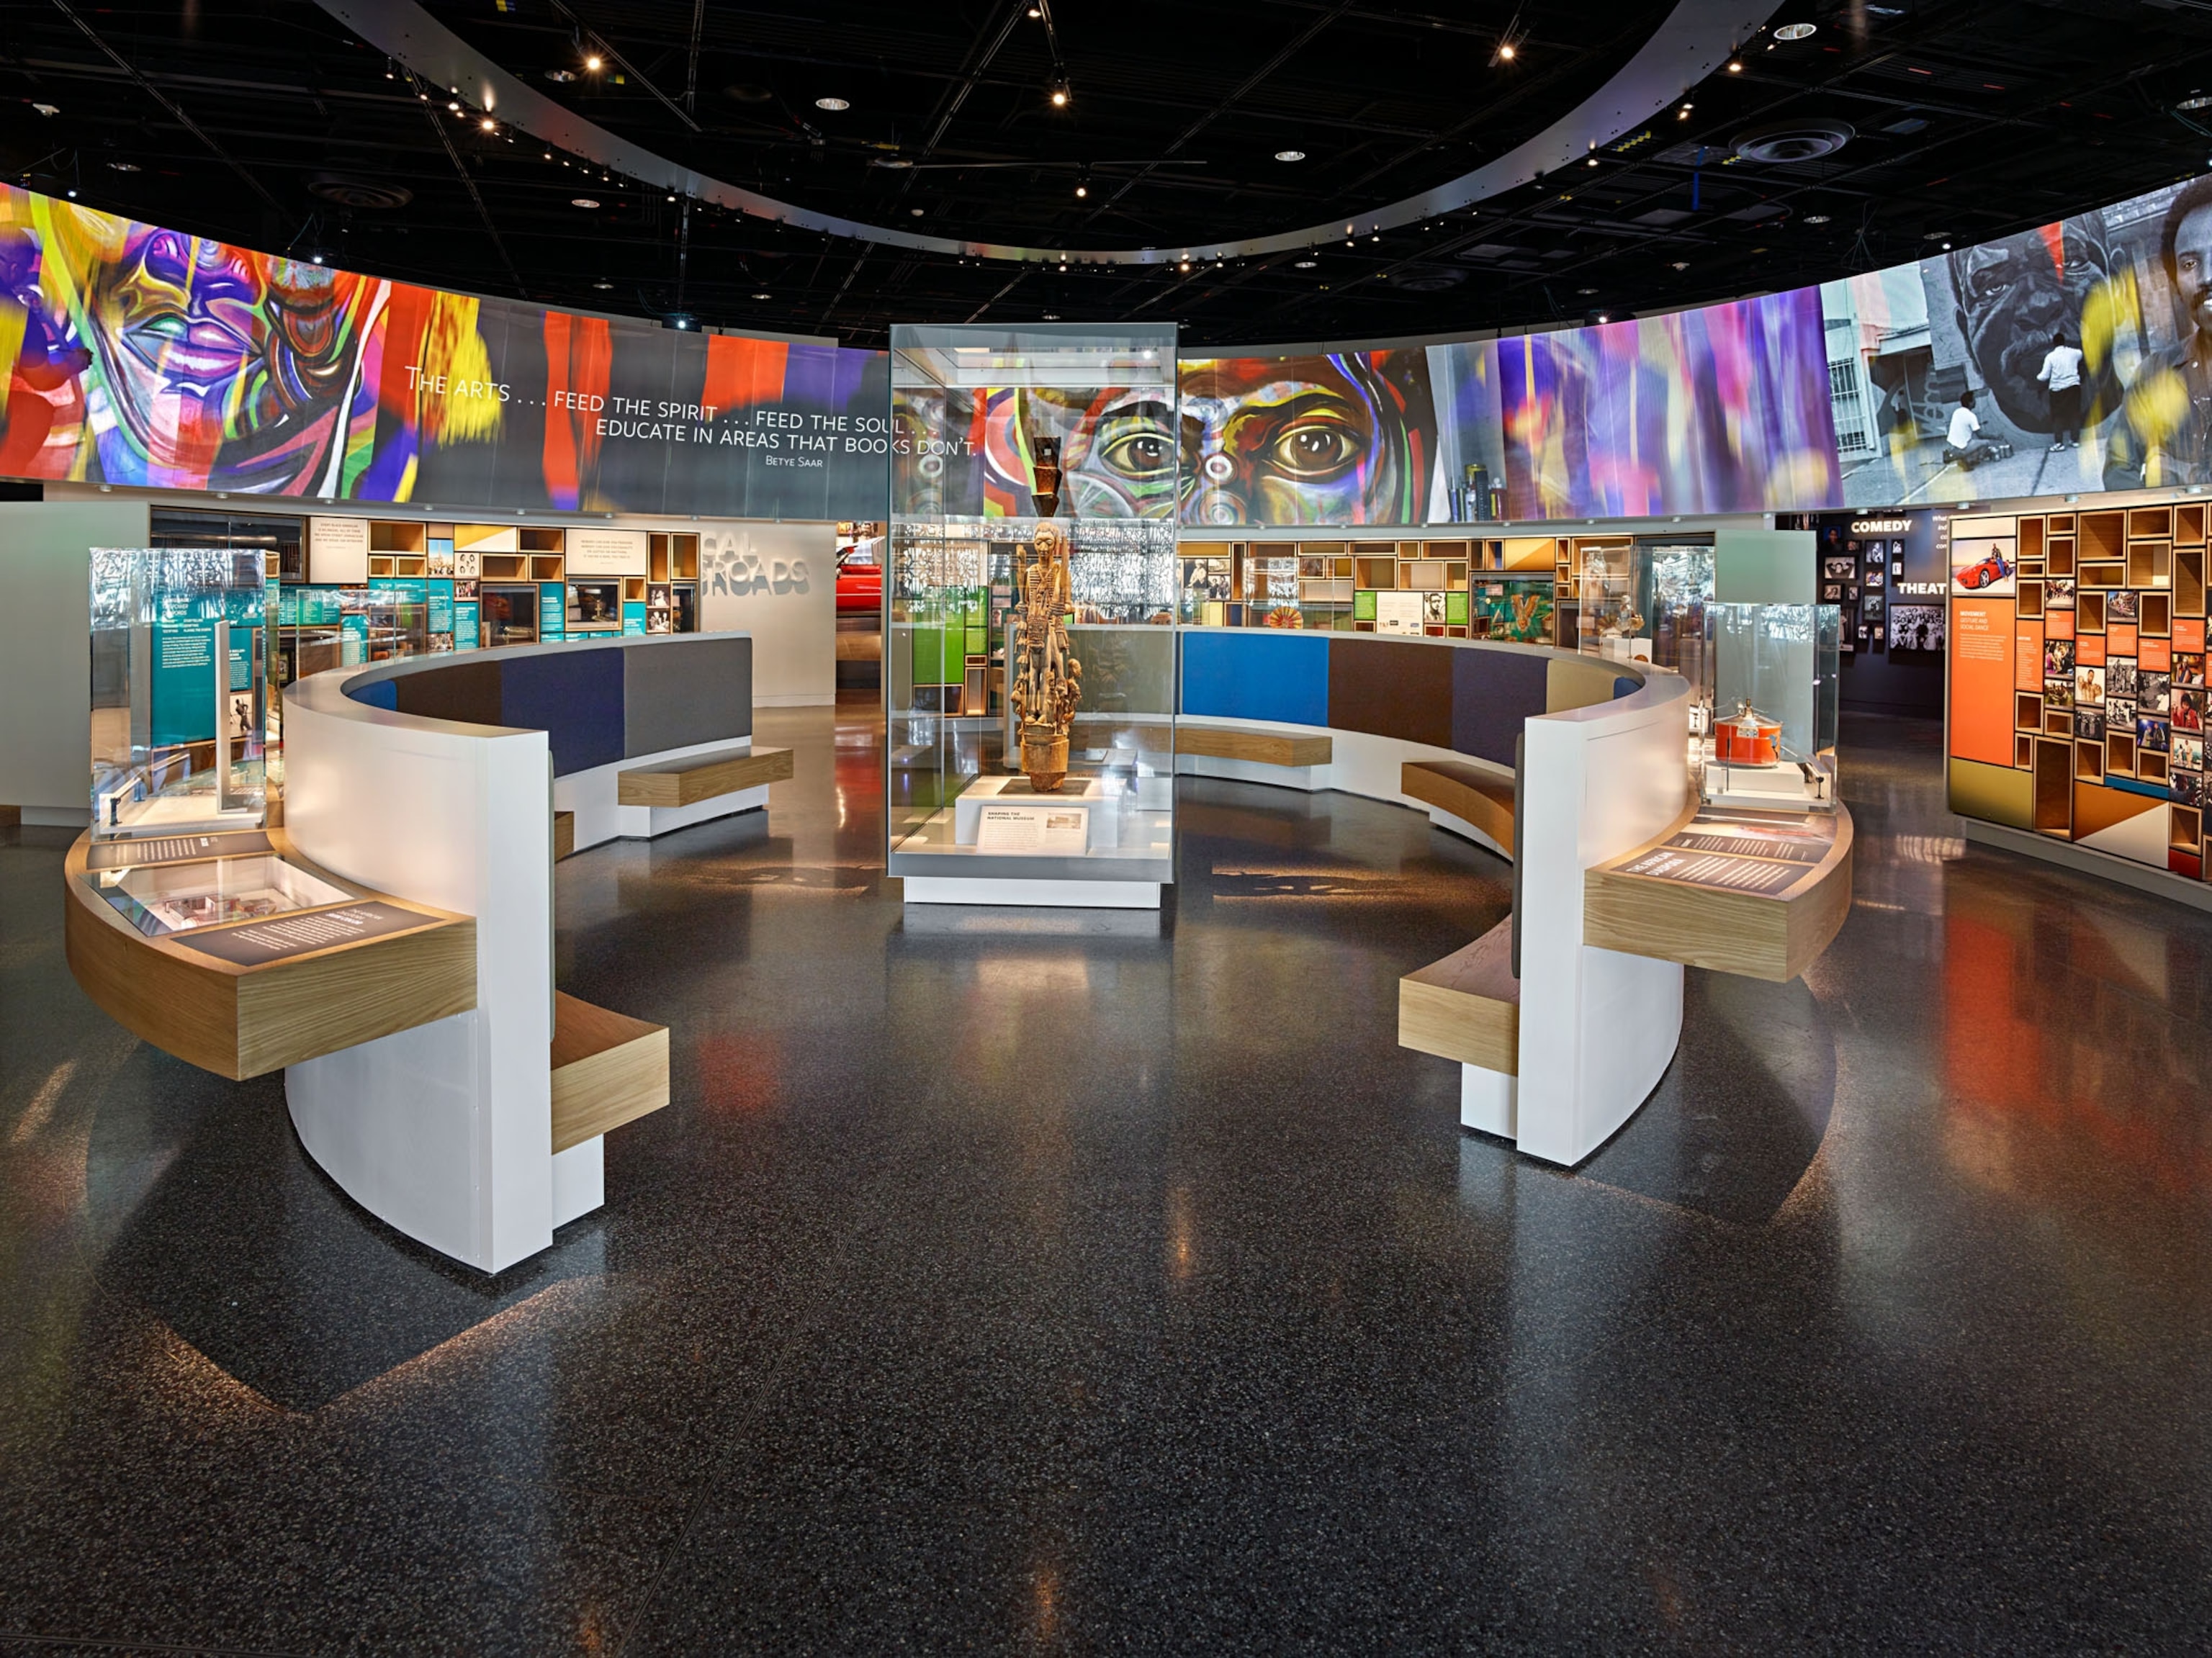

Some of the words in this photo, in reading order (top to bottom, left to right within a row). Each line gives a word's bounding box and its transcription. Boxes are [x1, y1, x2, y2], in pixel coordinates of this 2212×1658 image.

[454, 379, 511, 402] ARTS
[554, 391, 604, 412] FEED
[613, 397, 651, 416] THE
[657, 402, 717, 422] SPIRIT
[756, 410, 803, 429] FEED
[810, 415, 848, 432] THE
[855, 417, 904, 434] SOUL
[595, 418, 686, 442] EDUCATE
[693, 426, 714, 444] IN
[720, 430, 780, 449] AREAS
[790, 435, 838, 452] THAT
[845, 437, 910, 455] BOOKS
[1851, 520, 1912, 533] COMEDY
